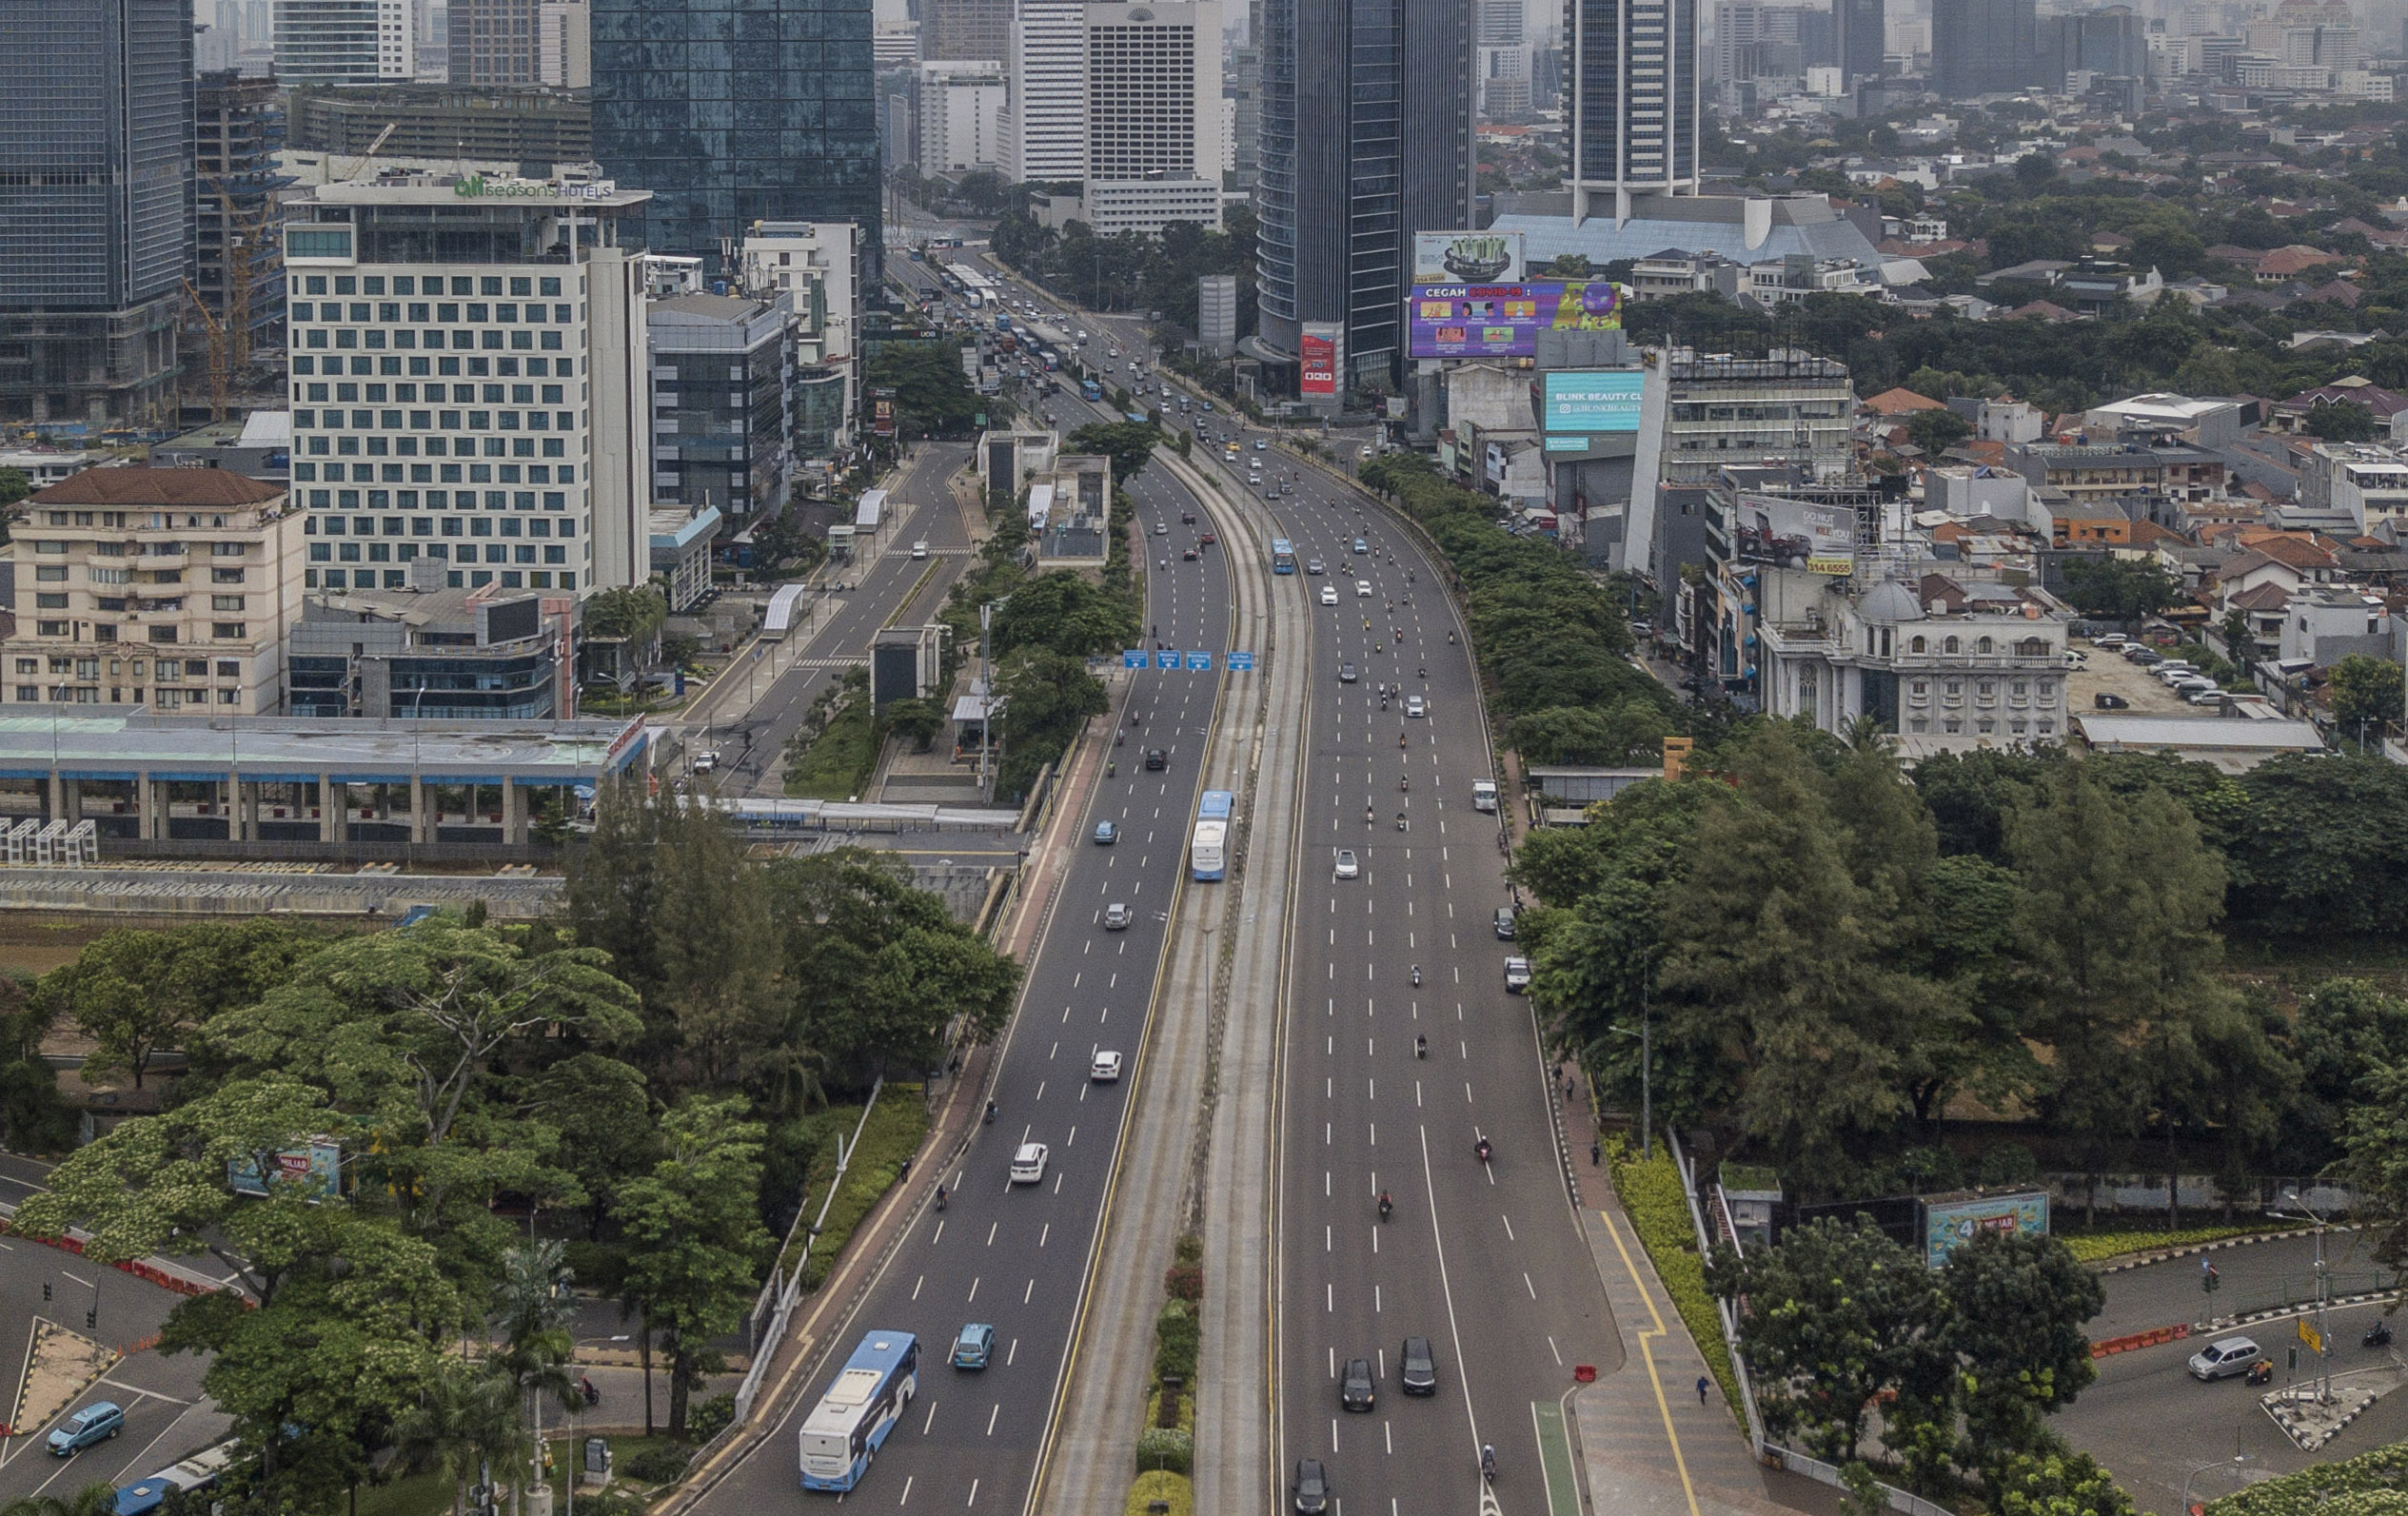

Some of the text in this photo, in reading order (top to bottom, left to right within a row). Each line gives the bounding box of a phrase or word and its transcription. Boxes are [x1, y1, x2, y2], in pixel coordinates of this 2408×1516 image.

[558, 186, 611, 198] HOTELS
[1425, 287, 1466, 298] CEGAH
[1469, 286, 1522, 297] COVID-19
[1804, 511, 1835, 522] DO NOT
[1815, 525, 1850, 539] KILL YOU
[1808, 562, 1851, 573] 314 6555
[1959, 1218, 1974, 1237] 4
